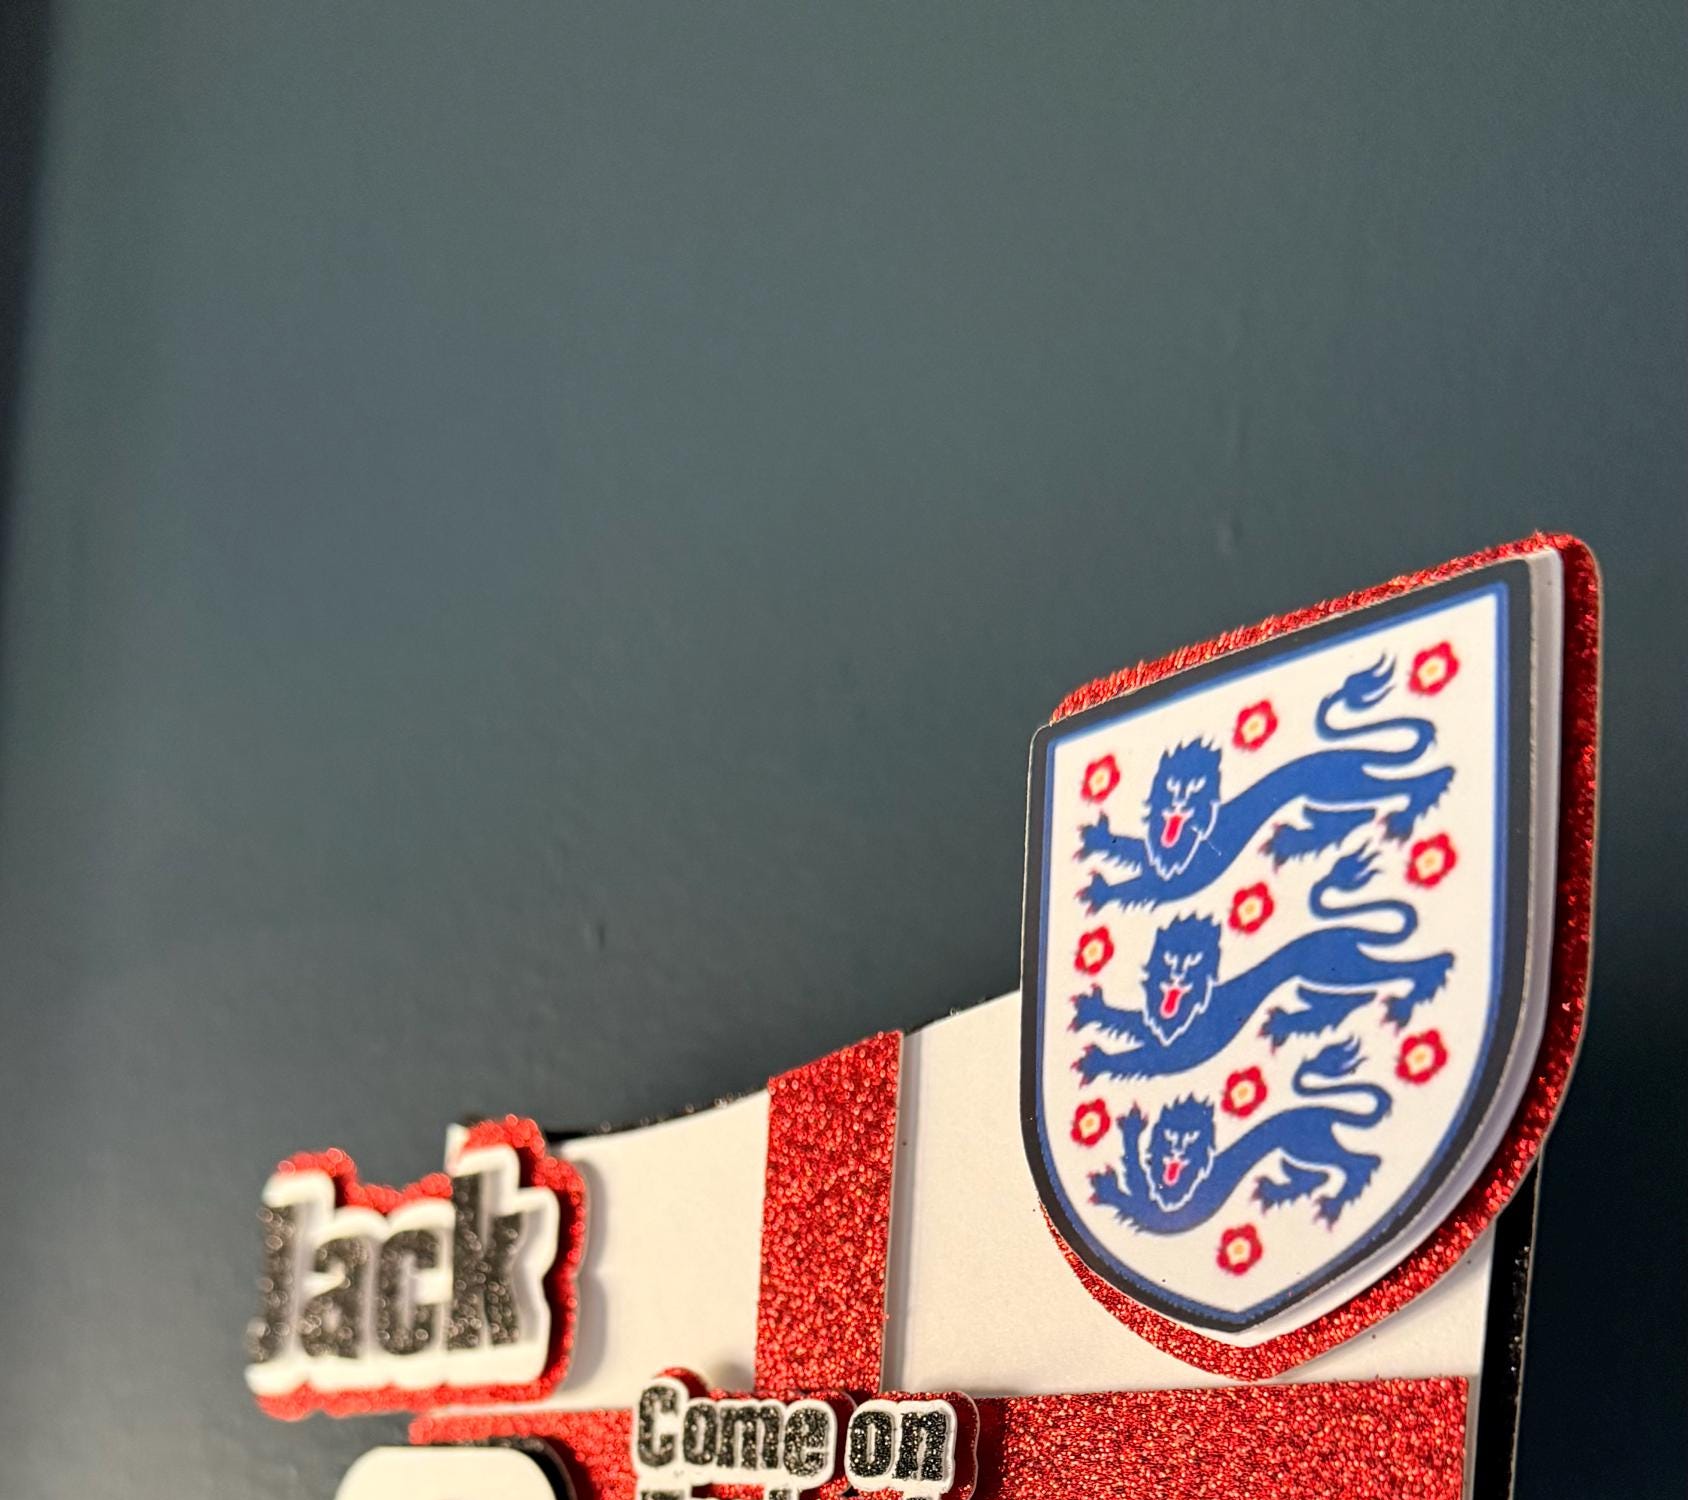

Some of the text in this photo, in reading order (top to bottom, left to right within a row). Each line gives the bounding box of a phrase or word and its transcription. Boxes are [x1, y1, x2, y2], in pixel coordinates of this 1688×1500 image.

[246, 1172, 524, 1364] Jack
[637, 1385, 948, 1482] Come on
